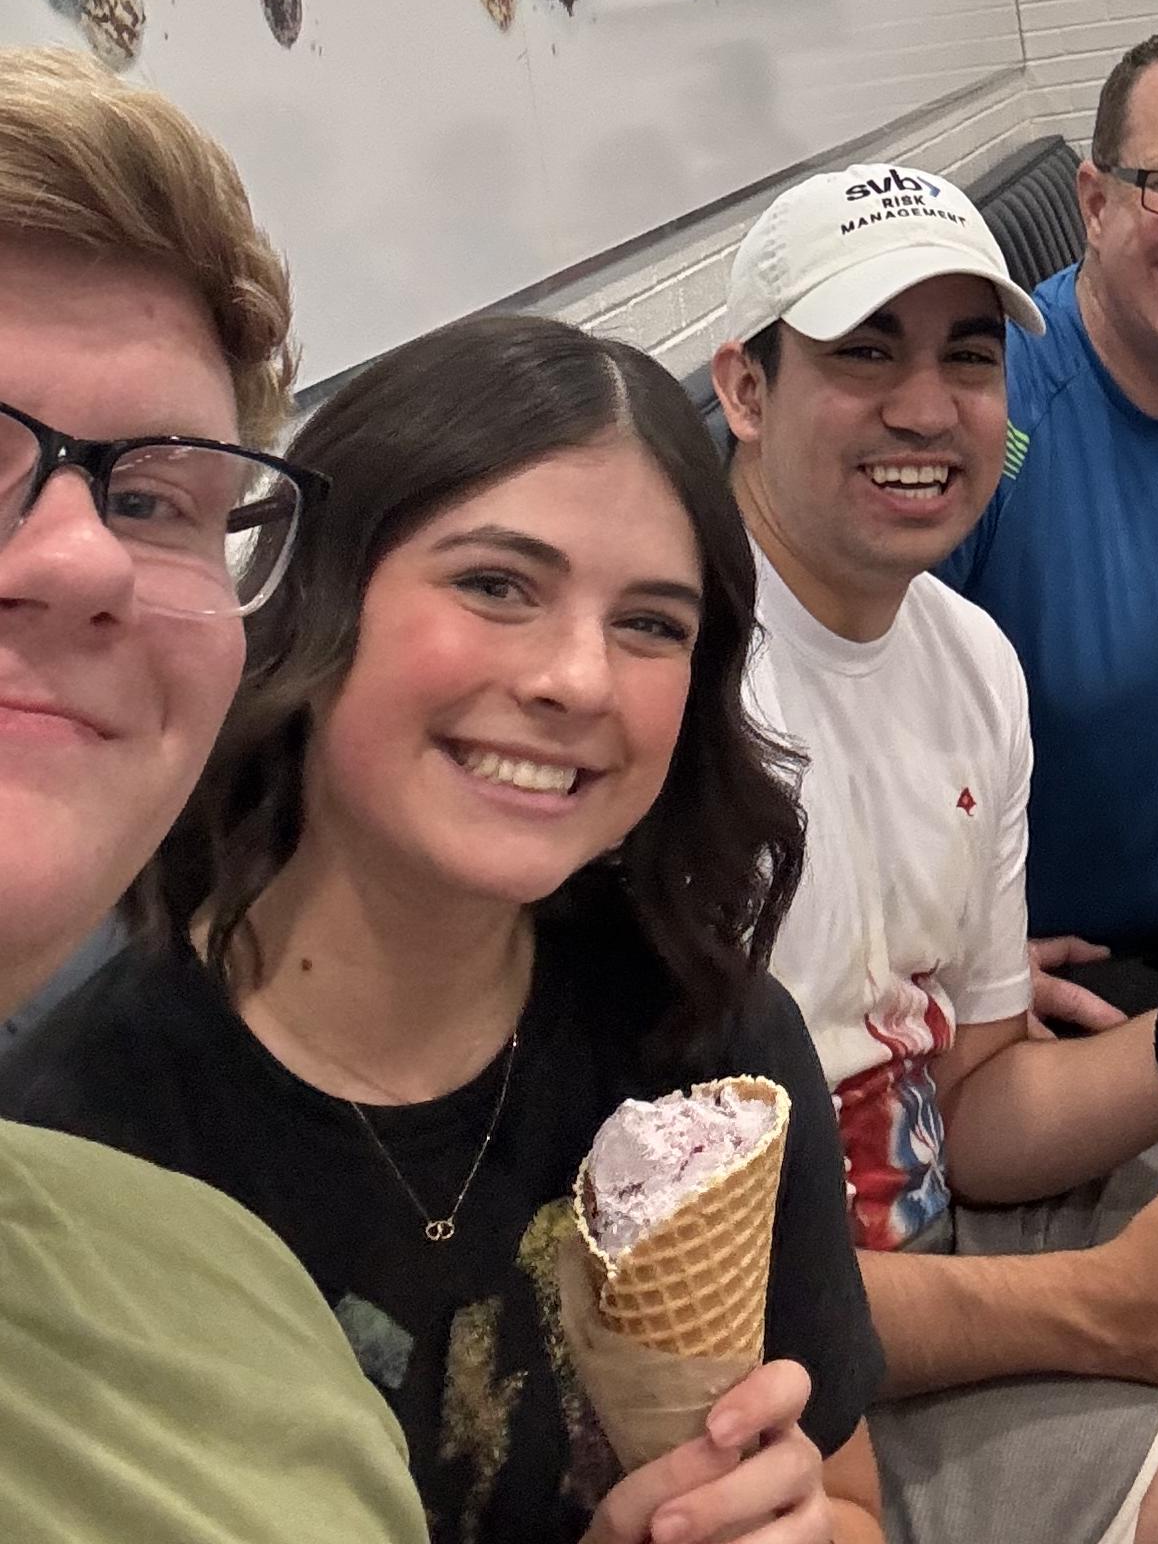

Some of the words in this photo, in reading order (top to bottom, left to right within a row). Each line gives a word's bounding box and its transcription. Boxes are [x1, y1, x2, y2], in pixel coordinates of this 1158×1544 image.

[845, 169, 921, 202] svb
[881, 194, 926, 209] RISK
[840, 207, 967, 236] MANAGEMENT
